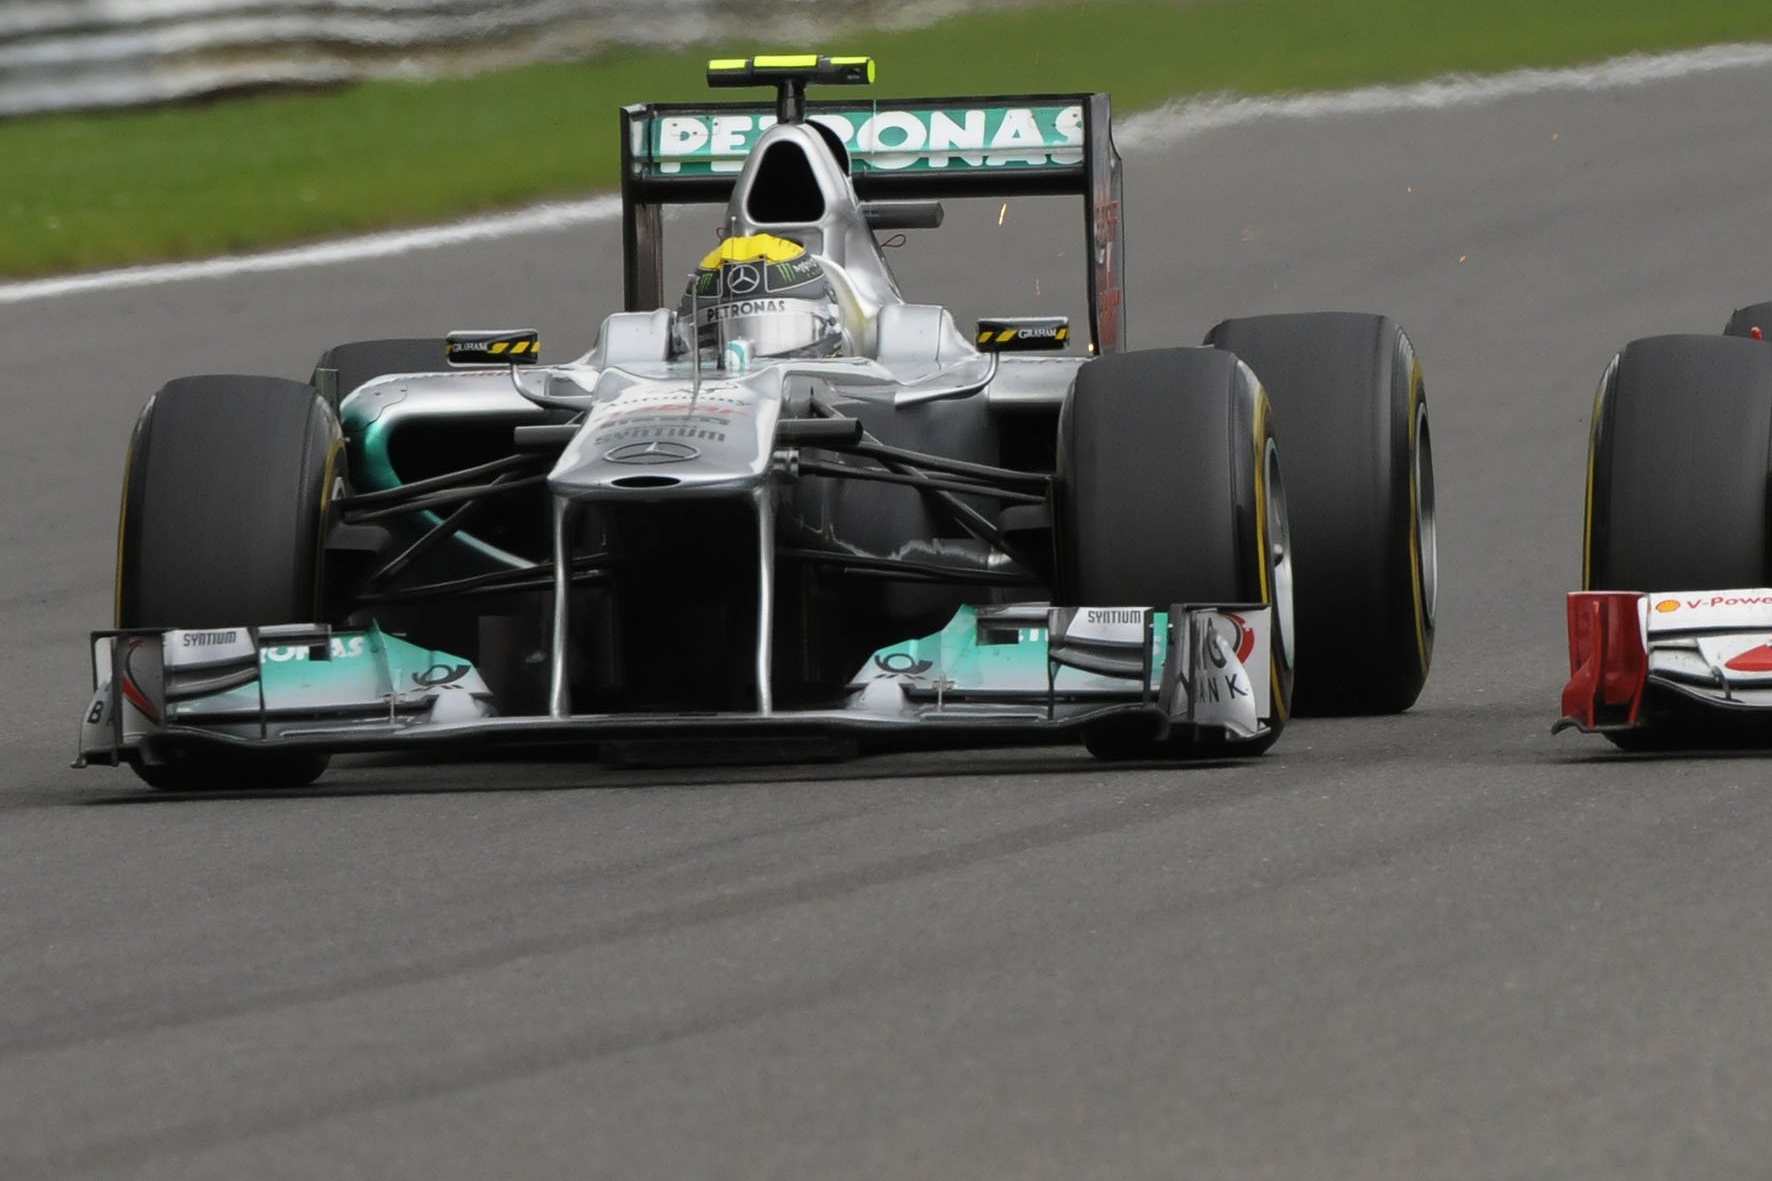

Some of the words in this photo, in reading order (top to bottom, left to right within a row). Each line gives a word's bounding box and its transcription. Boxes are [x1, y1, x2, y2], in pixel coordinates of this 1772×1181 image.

[660, 106, 1084, 173] PEONAS
[707, 301, 785, 322] PETRONAS
[1088, 610, 1141, 624] SYNTIUM
[183, 631, 236, 646] SYNTIUM
